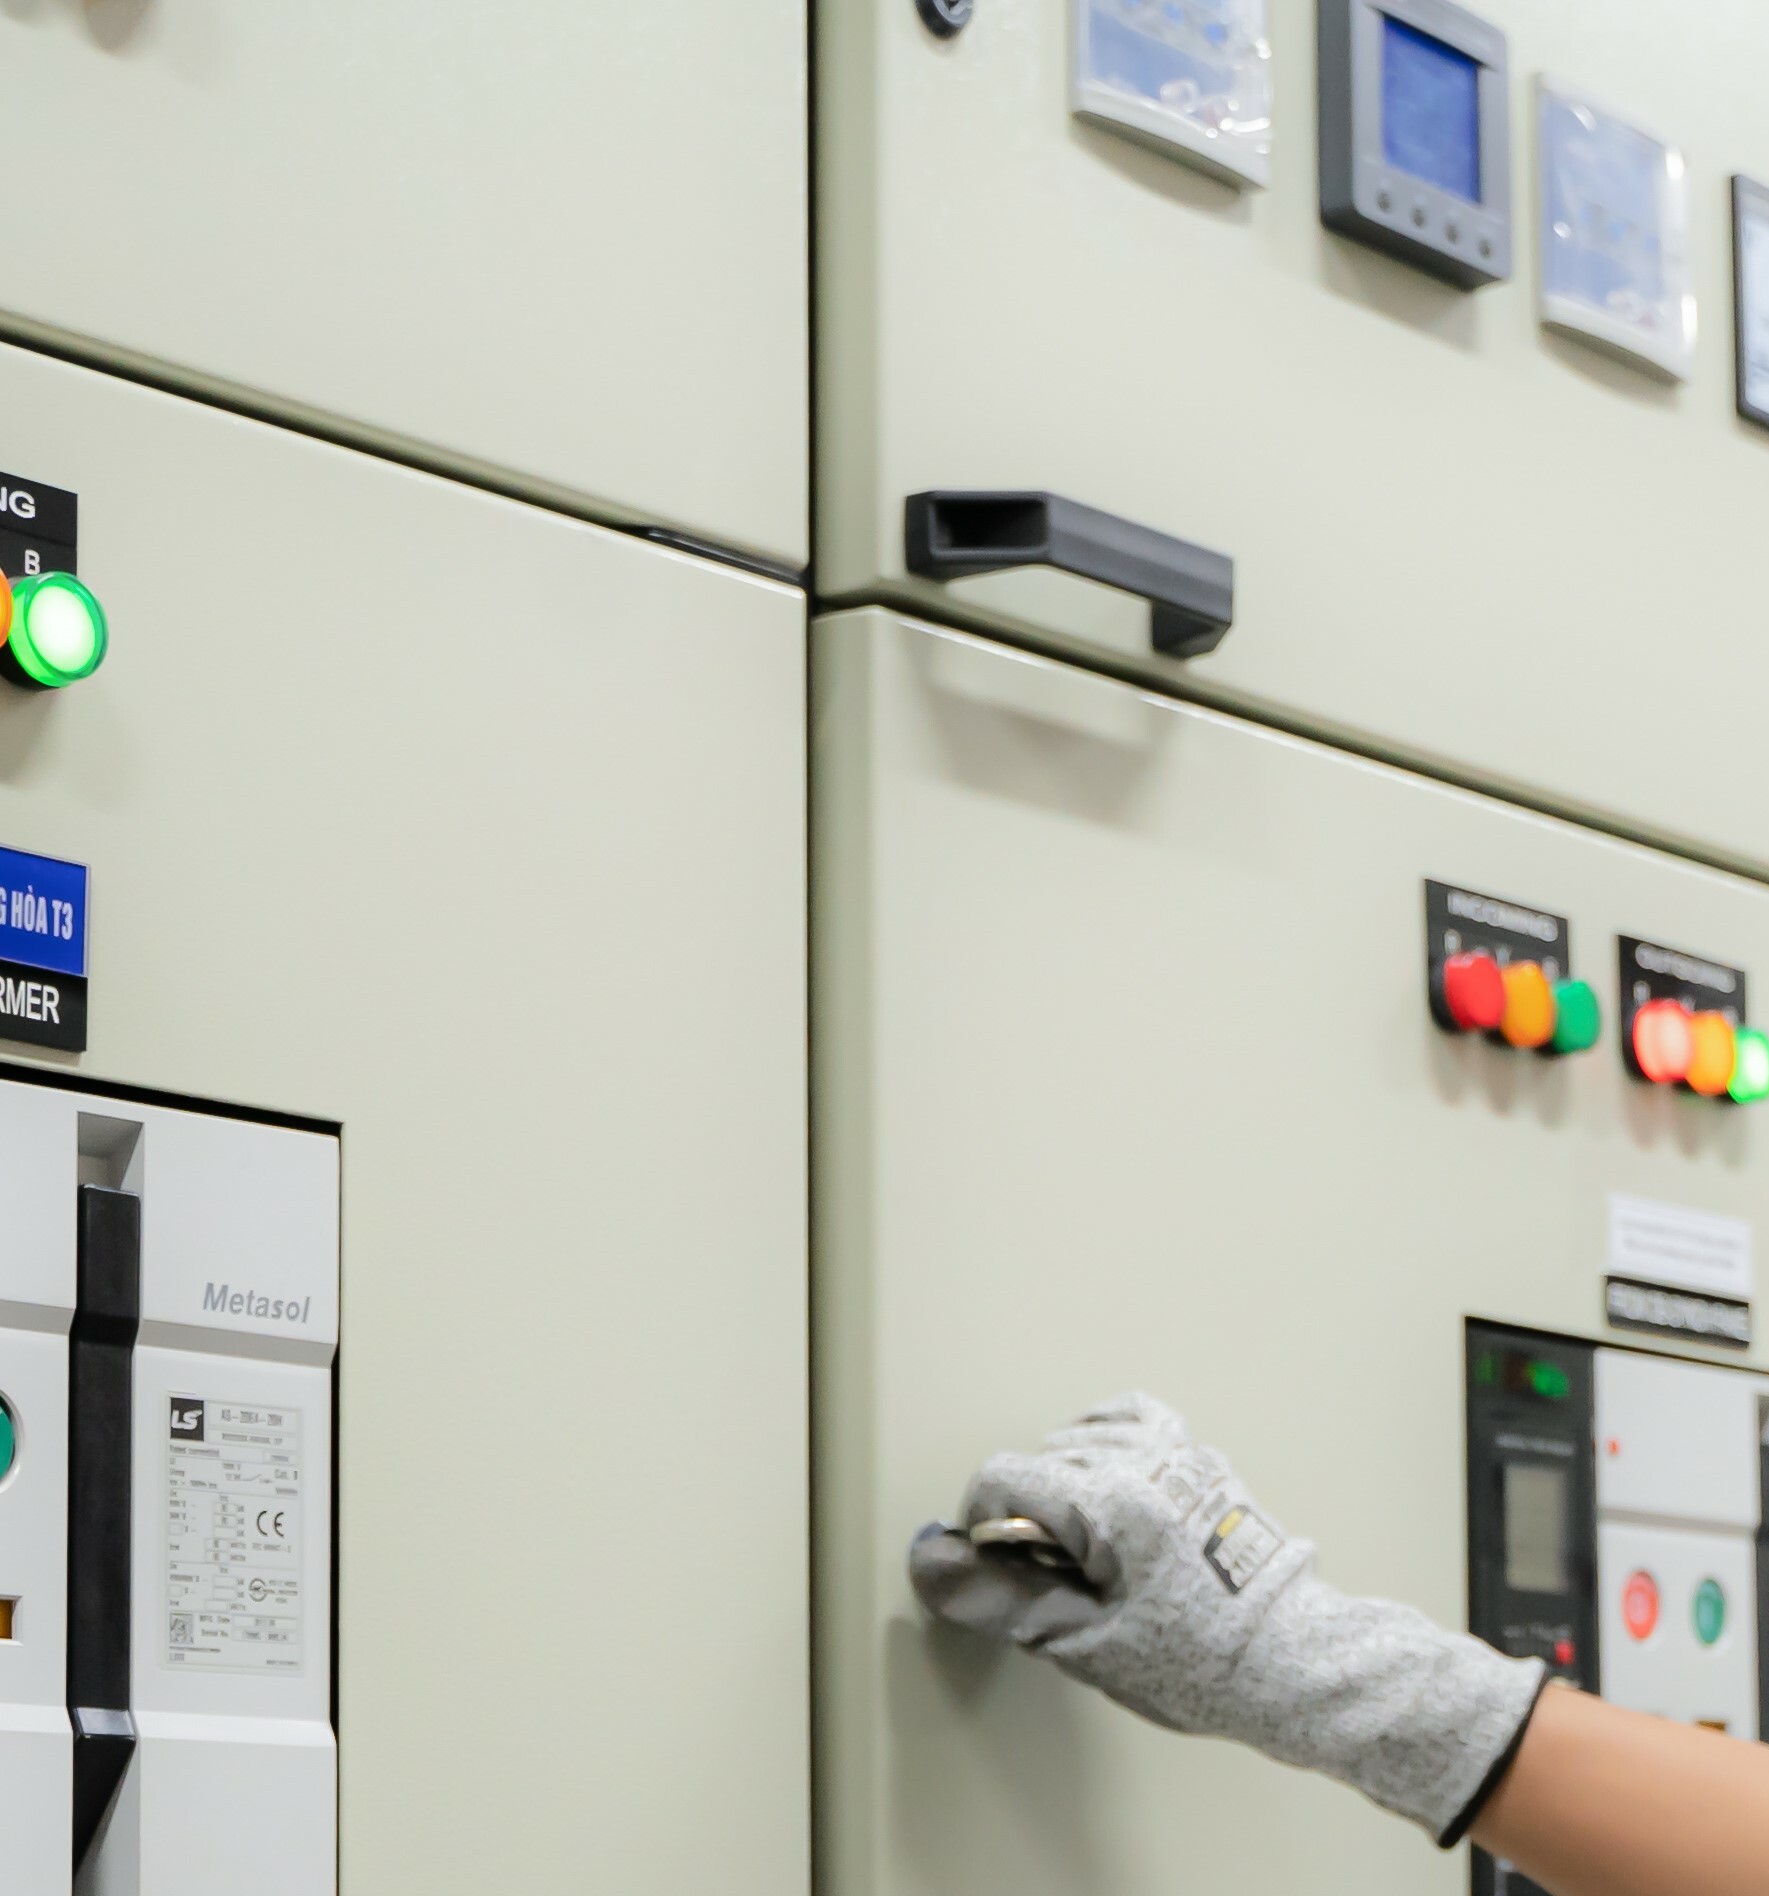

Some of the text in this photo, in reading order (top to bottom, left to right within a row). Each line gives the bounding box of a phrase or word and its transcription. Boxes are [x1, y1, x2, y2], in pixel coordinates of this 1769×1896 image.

[24, 548, 41, 576] B
[11, 884, 49, 935] HÒA
[51, 898, 74, 941] T3
[202, 1282, 310, 1324] Metasol
[170, 1408, 204, 1431] LS
